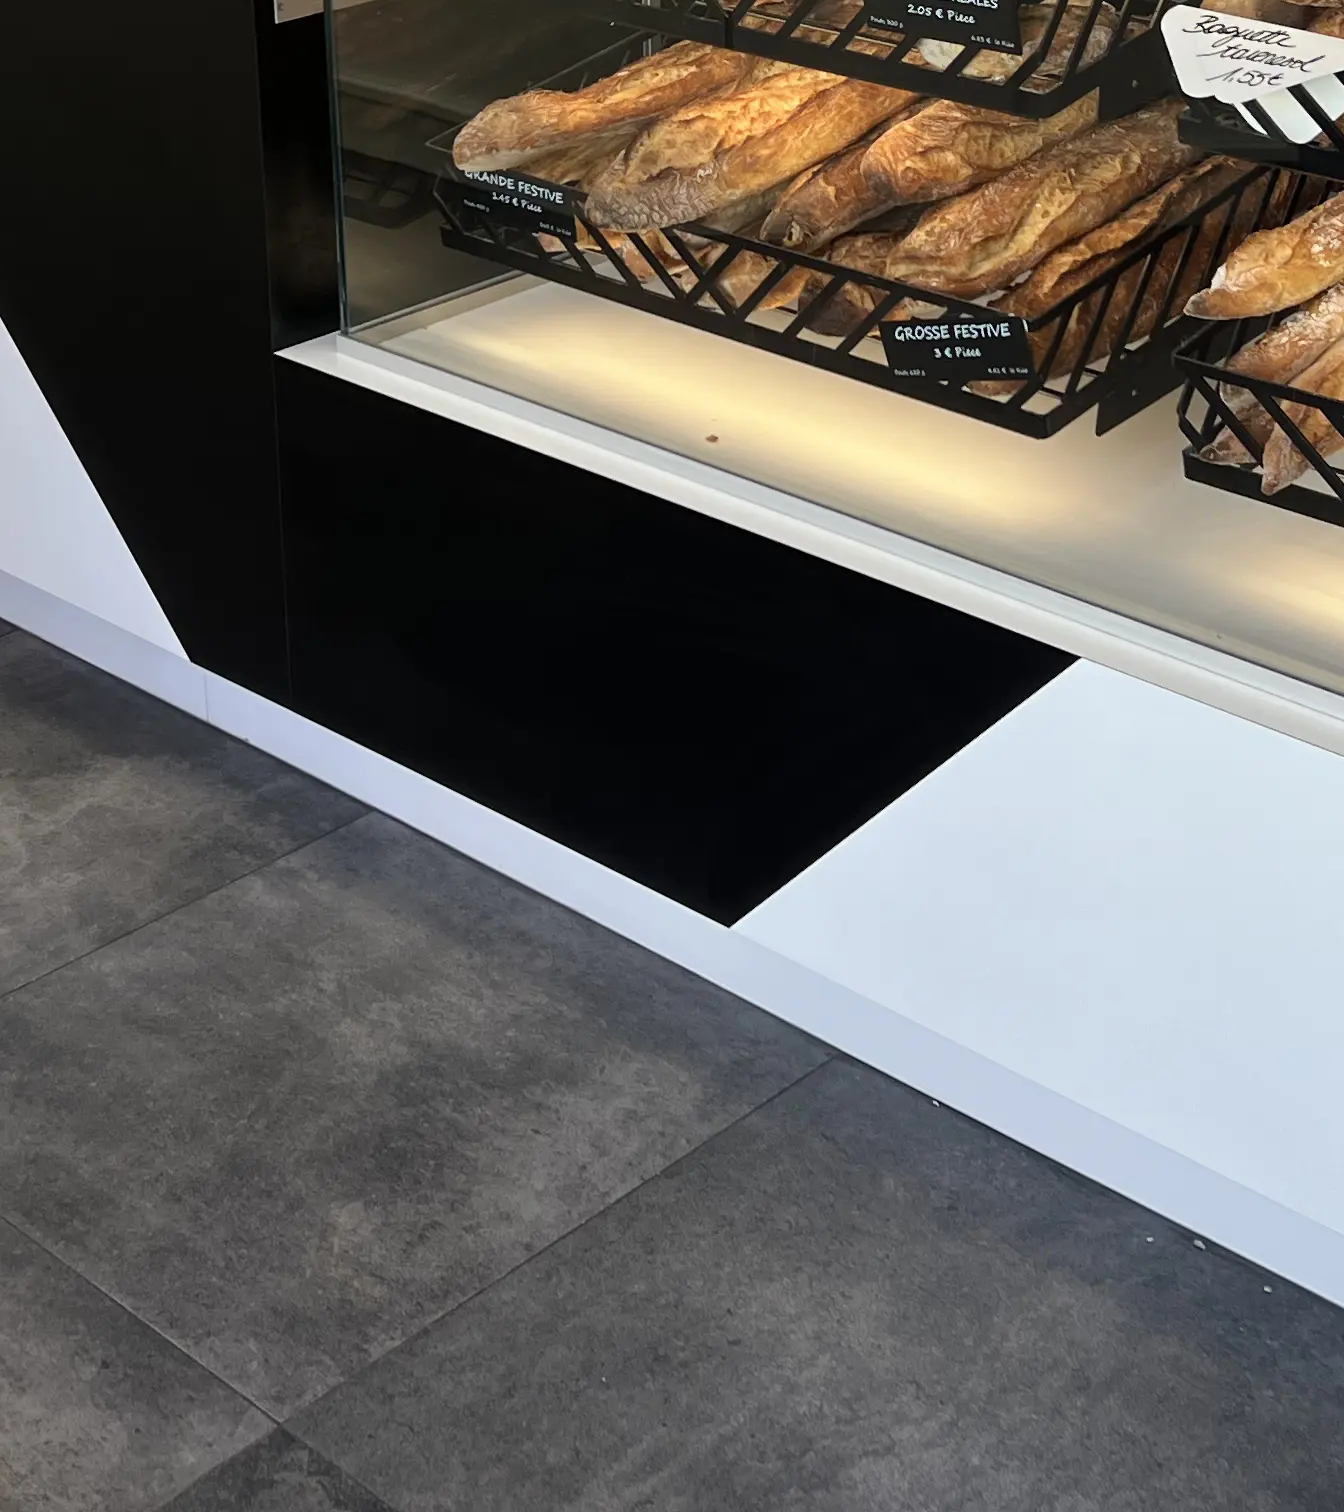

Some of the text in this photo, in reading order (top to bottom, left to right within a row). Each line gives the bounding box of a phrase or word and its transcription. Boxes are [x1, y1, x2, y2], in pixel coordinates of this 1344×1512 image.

[518, 181, 564, 204] FESTIVE
[895, 322, 1011, 342] GROSSE FESTIVE
